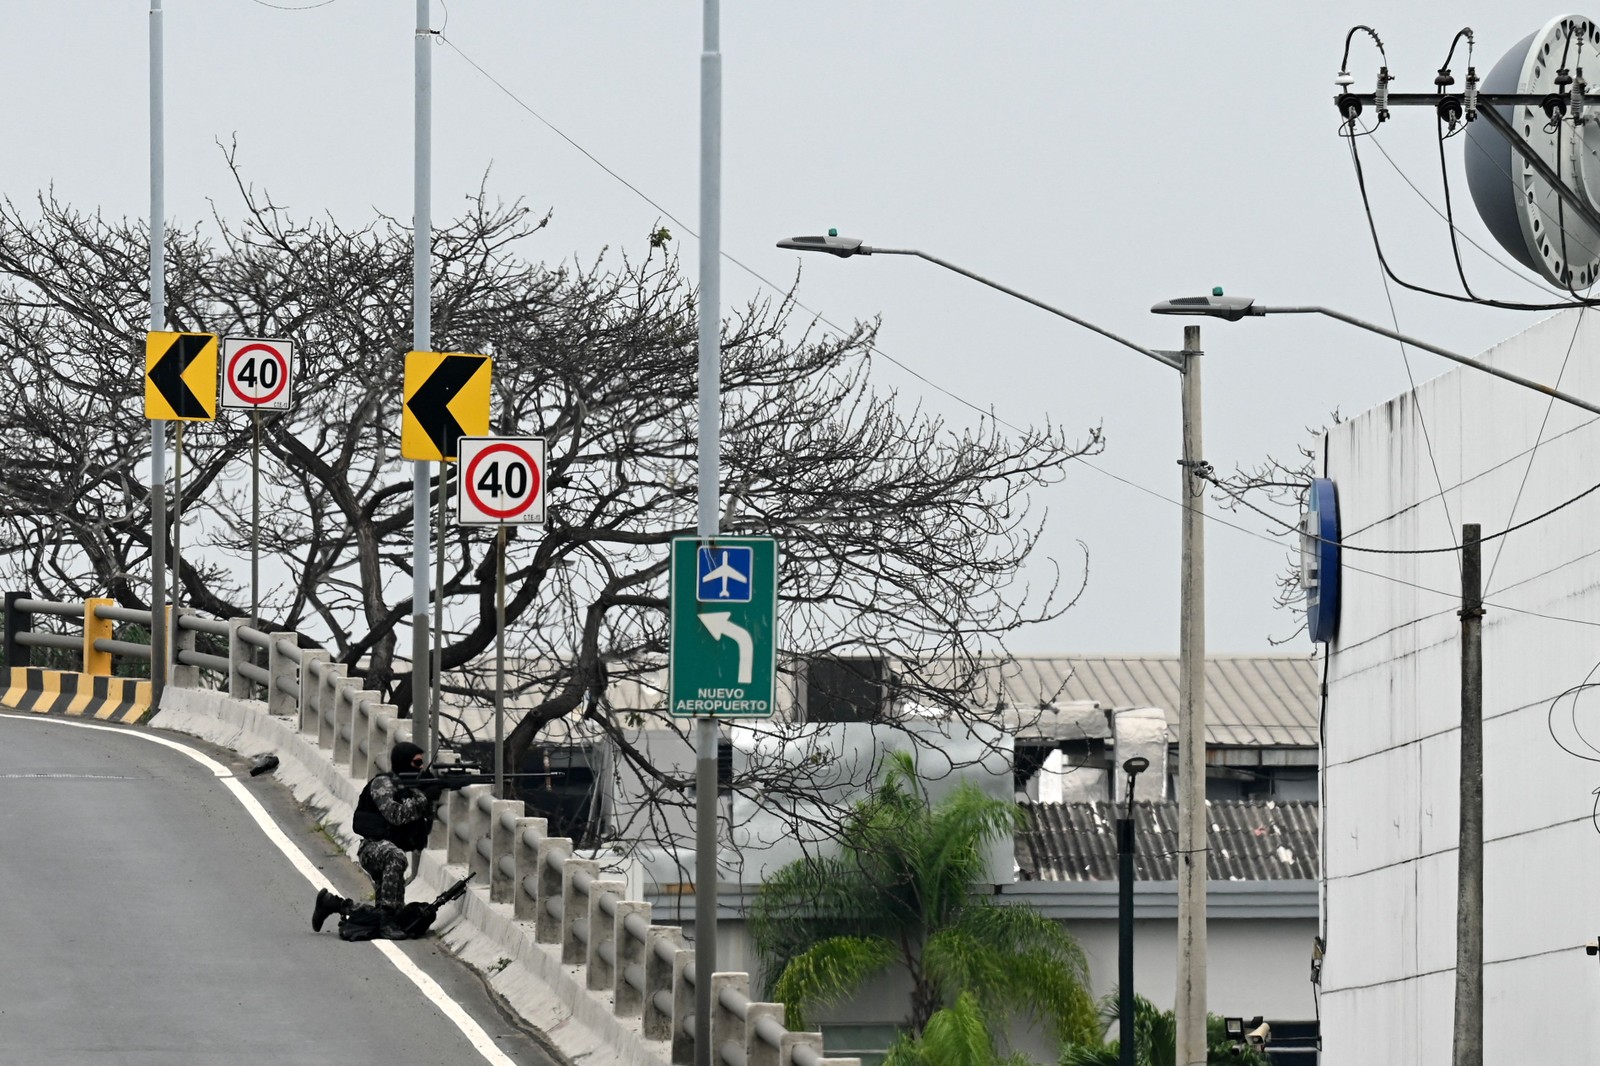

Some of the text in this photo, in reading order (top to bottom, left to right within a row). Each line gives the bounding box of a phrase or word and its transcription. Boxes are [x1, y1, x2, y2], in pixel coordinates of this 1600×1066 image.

[237, 358, 278, 389] 40
[477, 461, 527, 499] 40
[698, 688, 744, 699] NUEVO
[676, 700, 767, 711] AEROPUERTO
